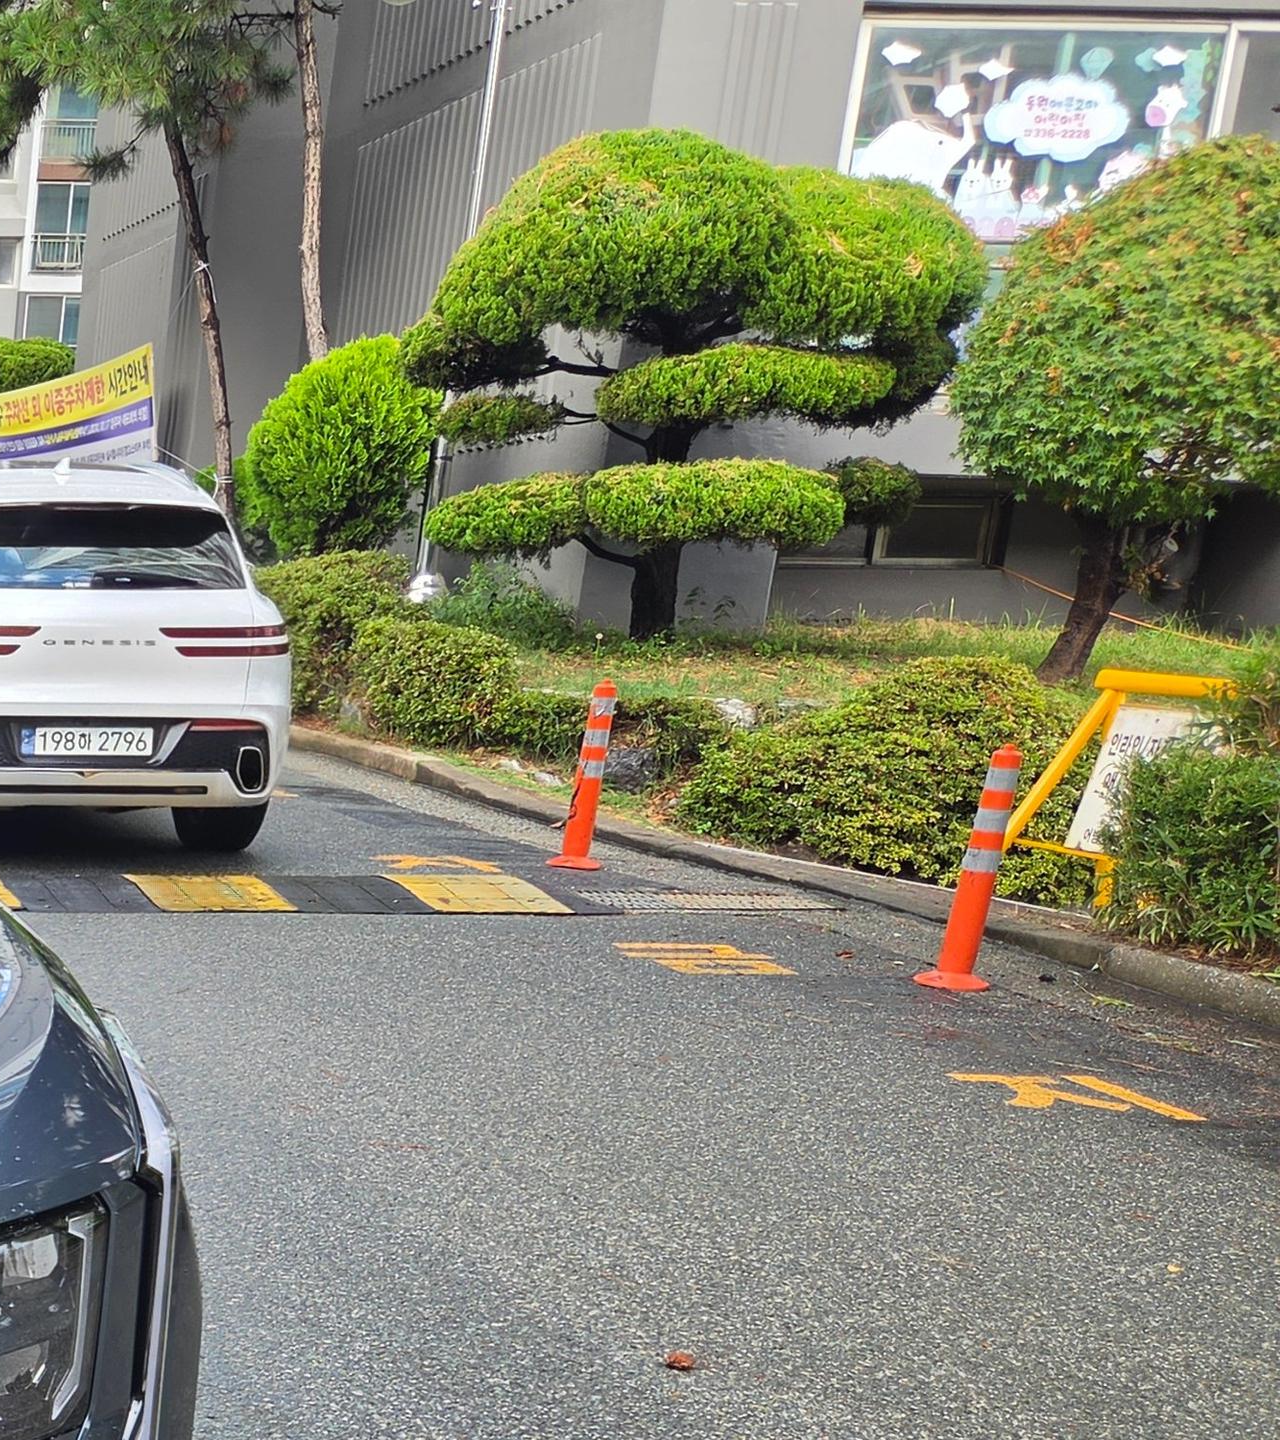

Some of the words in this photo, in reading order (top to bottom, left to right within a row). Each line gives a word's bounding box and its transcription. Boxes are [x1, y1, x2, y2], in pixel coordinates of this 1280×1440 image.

[108, 354, 151, 399] 시간안내
[42, 638, 157, 647] GENESIS
[39, 731, 91, 752] 198하
[98, 731, 148, 752] 2796
